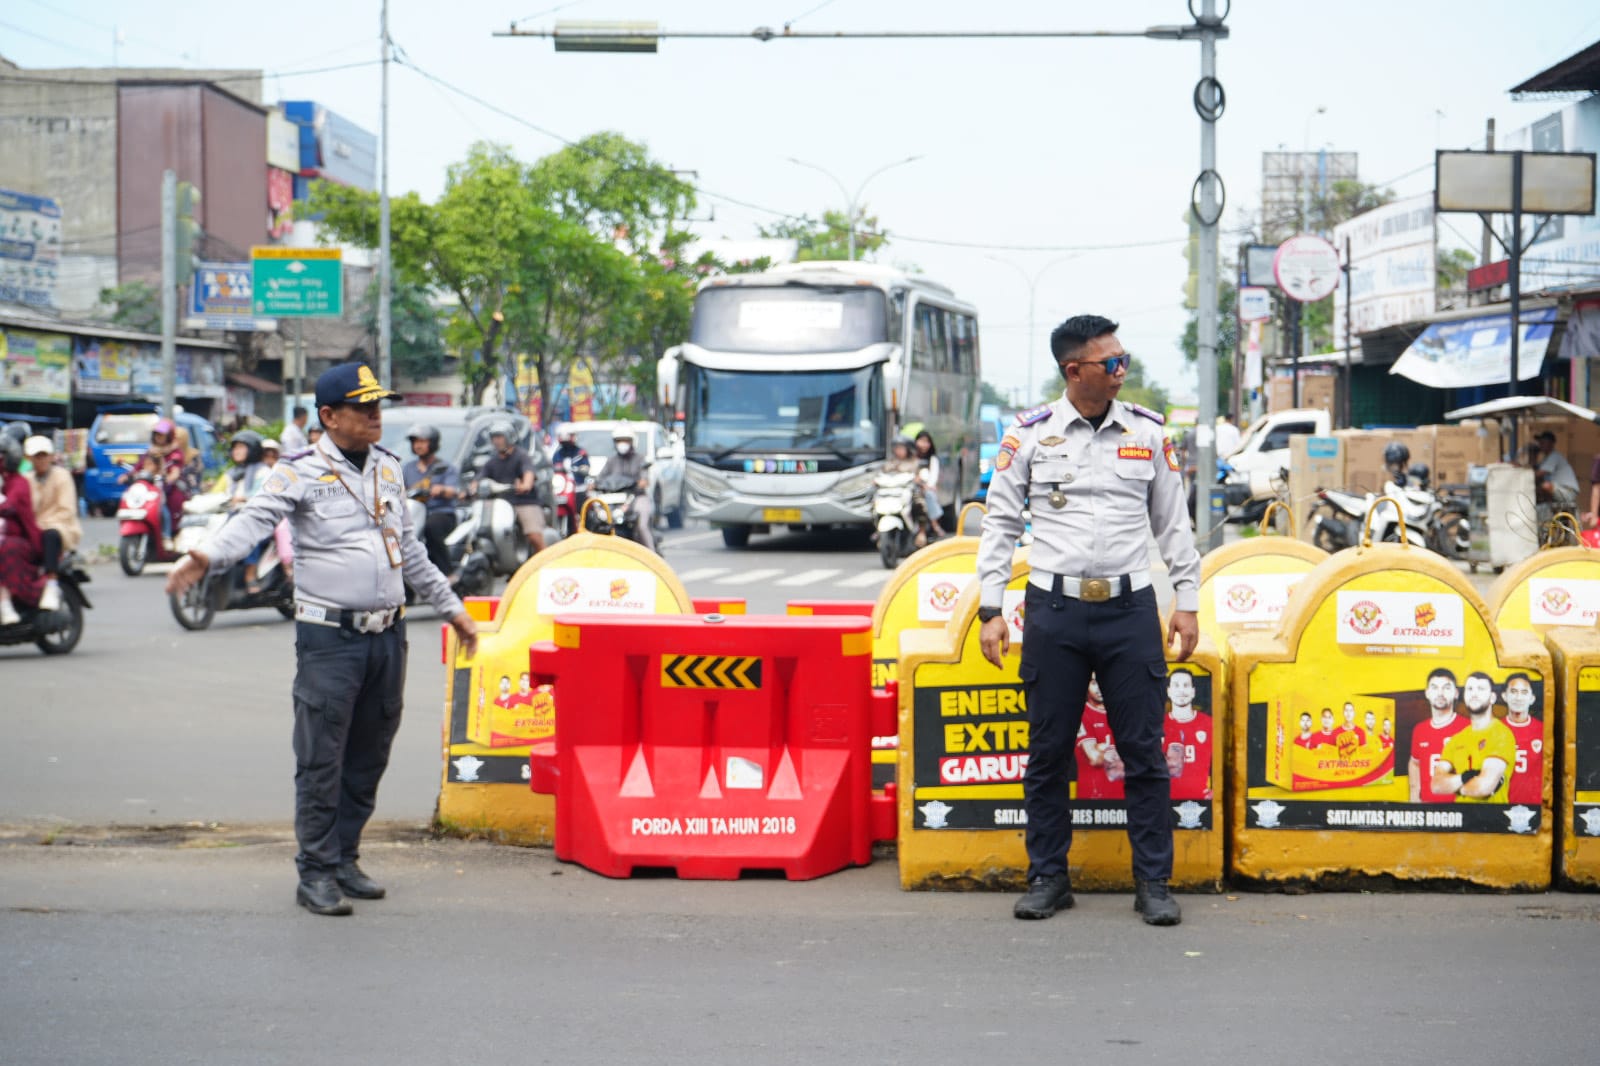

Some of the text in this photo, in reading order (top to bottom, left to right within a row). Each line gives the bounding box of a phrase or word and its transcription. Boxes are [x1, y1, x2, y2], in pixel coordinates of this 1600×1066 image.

[1392, 628, 1454, 637] EXTRAJOSS
[944, 721, 1030, 753] EXTR
[1318, 760, 1371, 769] EXTRAJOSS
[994, 809, 1029, 824] SATLA
[1070, 809, 1093, 824] RES
[1326, 809, 1463, 828] SATLANTAS POLRES BOGOR
[632, 817, 796, 835] PORDA XIII TAHUN 2018
